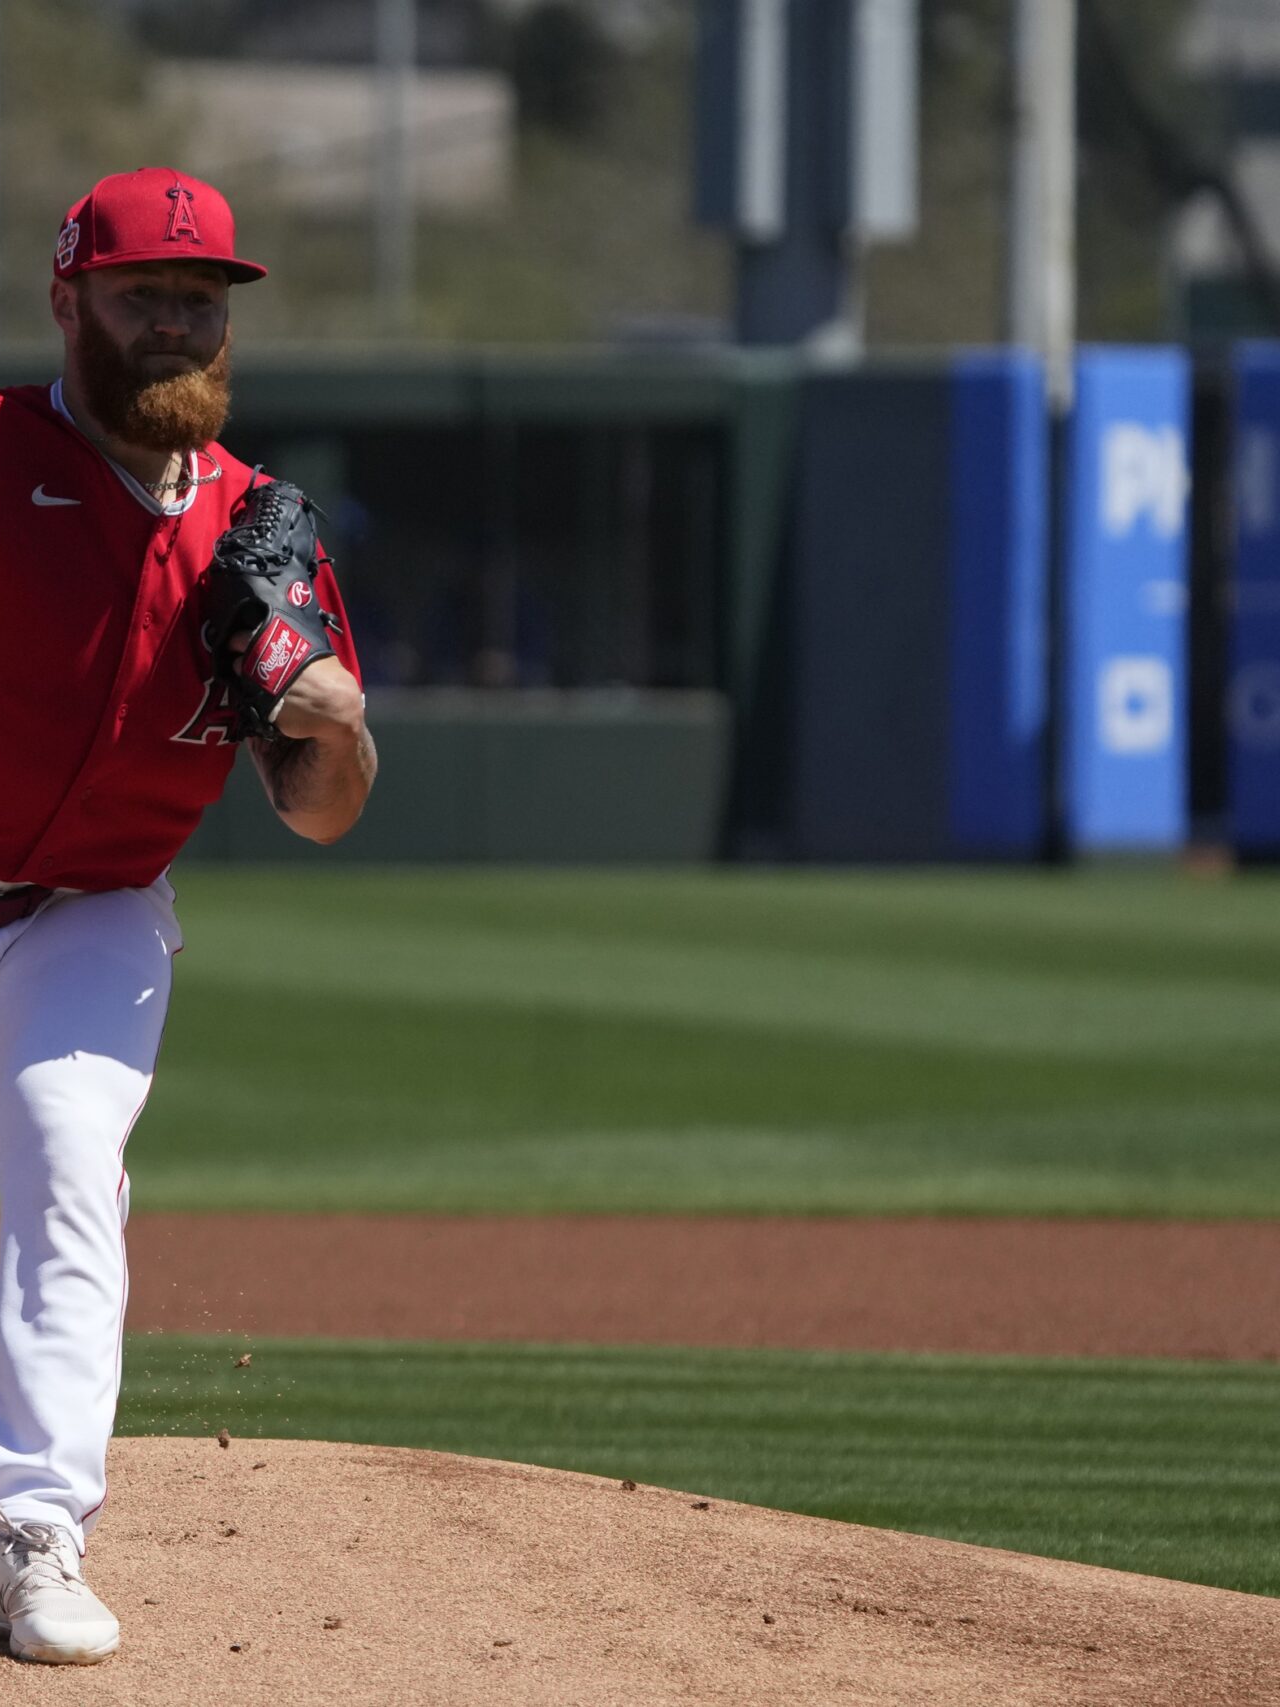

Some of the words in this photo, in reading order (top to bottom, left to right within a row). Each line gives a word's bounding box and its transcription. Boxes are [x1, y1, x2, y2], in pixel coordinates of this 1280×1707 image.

[162, 182, 205, 244] A
[291, 581, 311, 606] R
[257, 629, 293, 681] Rawlings
[168, 676, 240, 746] A
